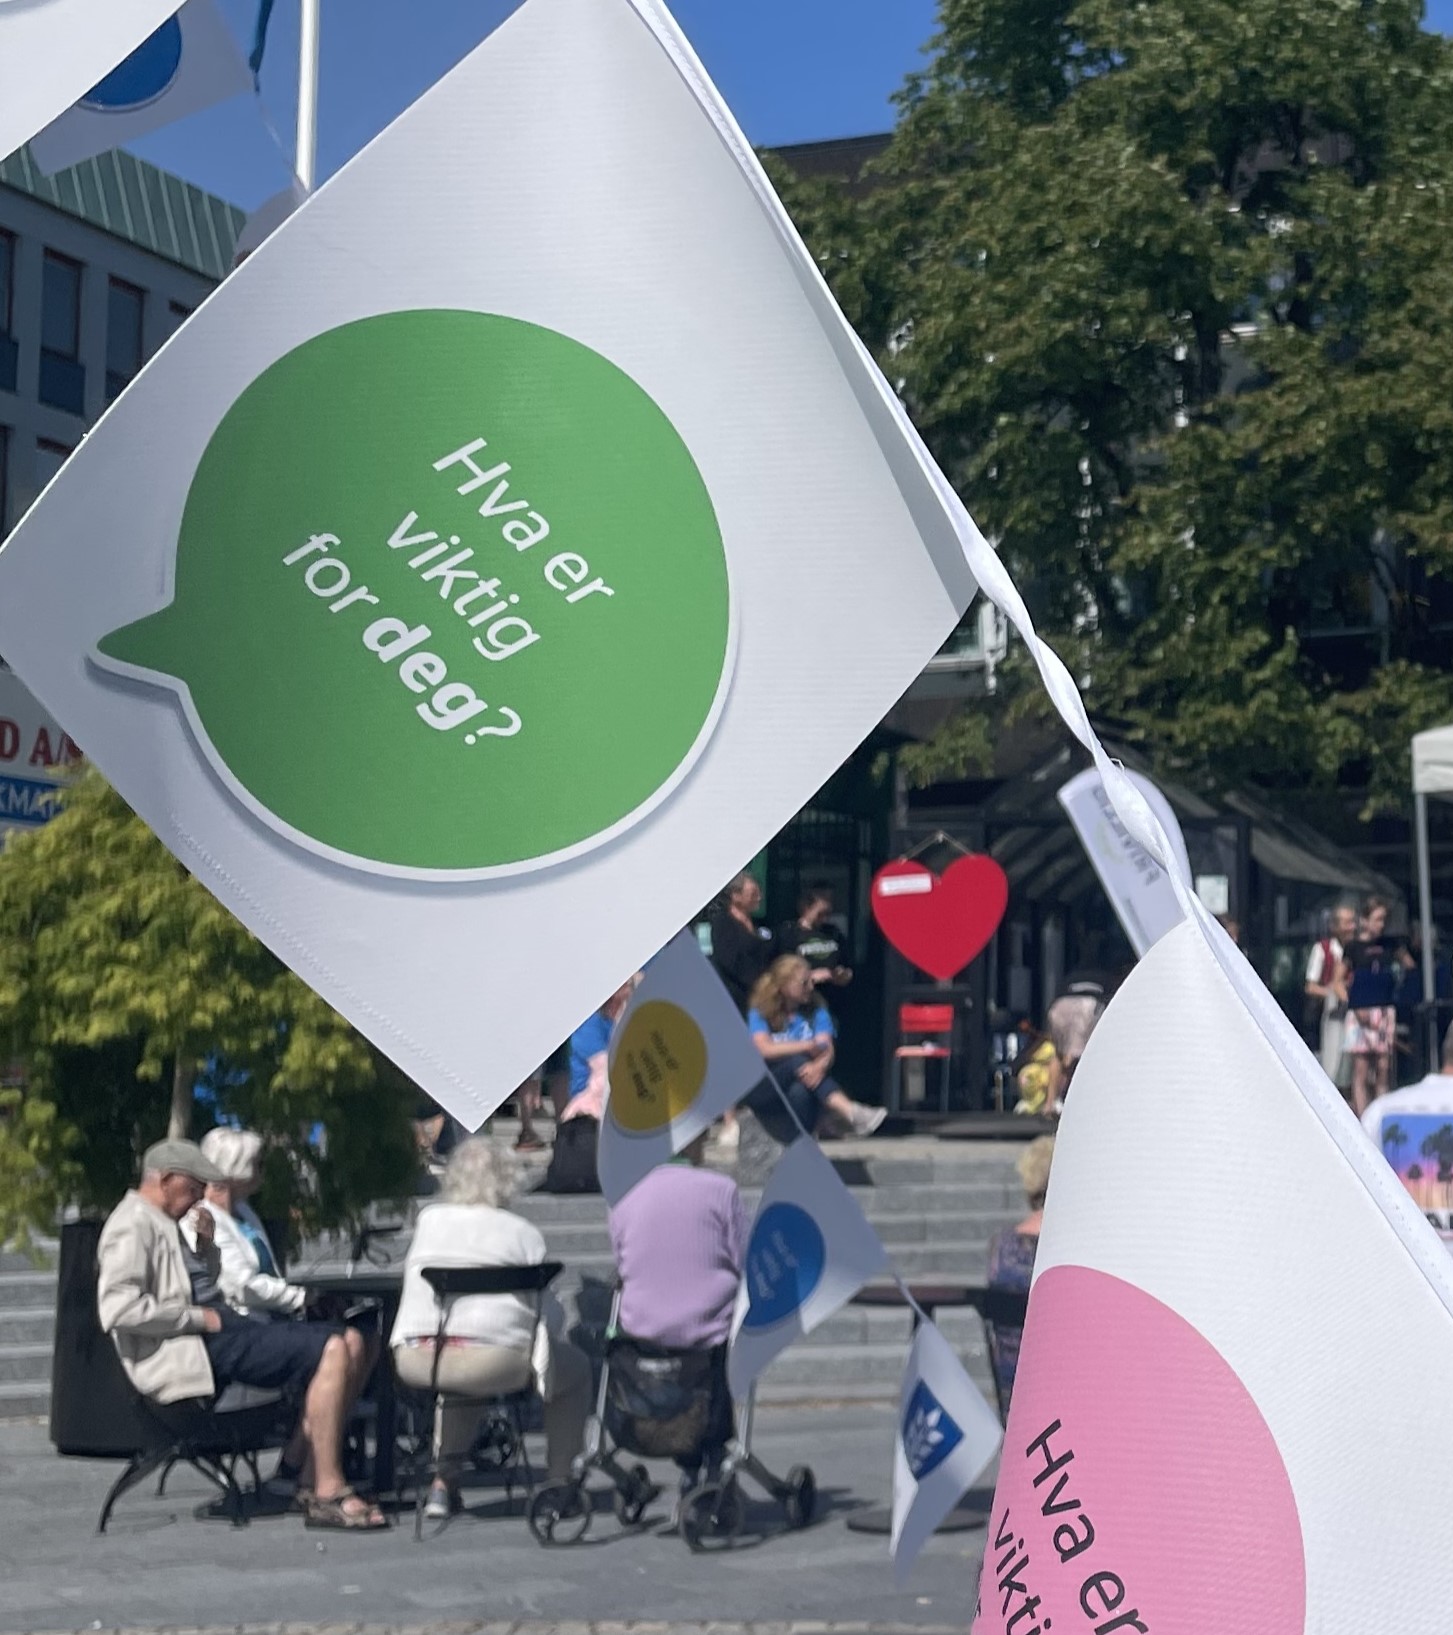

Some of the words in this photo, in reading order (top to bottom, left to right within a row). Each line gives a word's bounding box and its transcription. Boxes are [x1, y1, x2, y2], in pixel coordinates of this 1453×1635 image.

[386, 511, 541, 661] viktig
[432, 437, 551, 552] Hva
[544, 552, 616, 604] er
[283, 533, 380, 613] for
[362, 617, 522, 745] deg?
[1026, 1418, 1095, 1564] Hva
[1079, 1570, 1149, 1635] er
